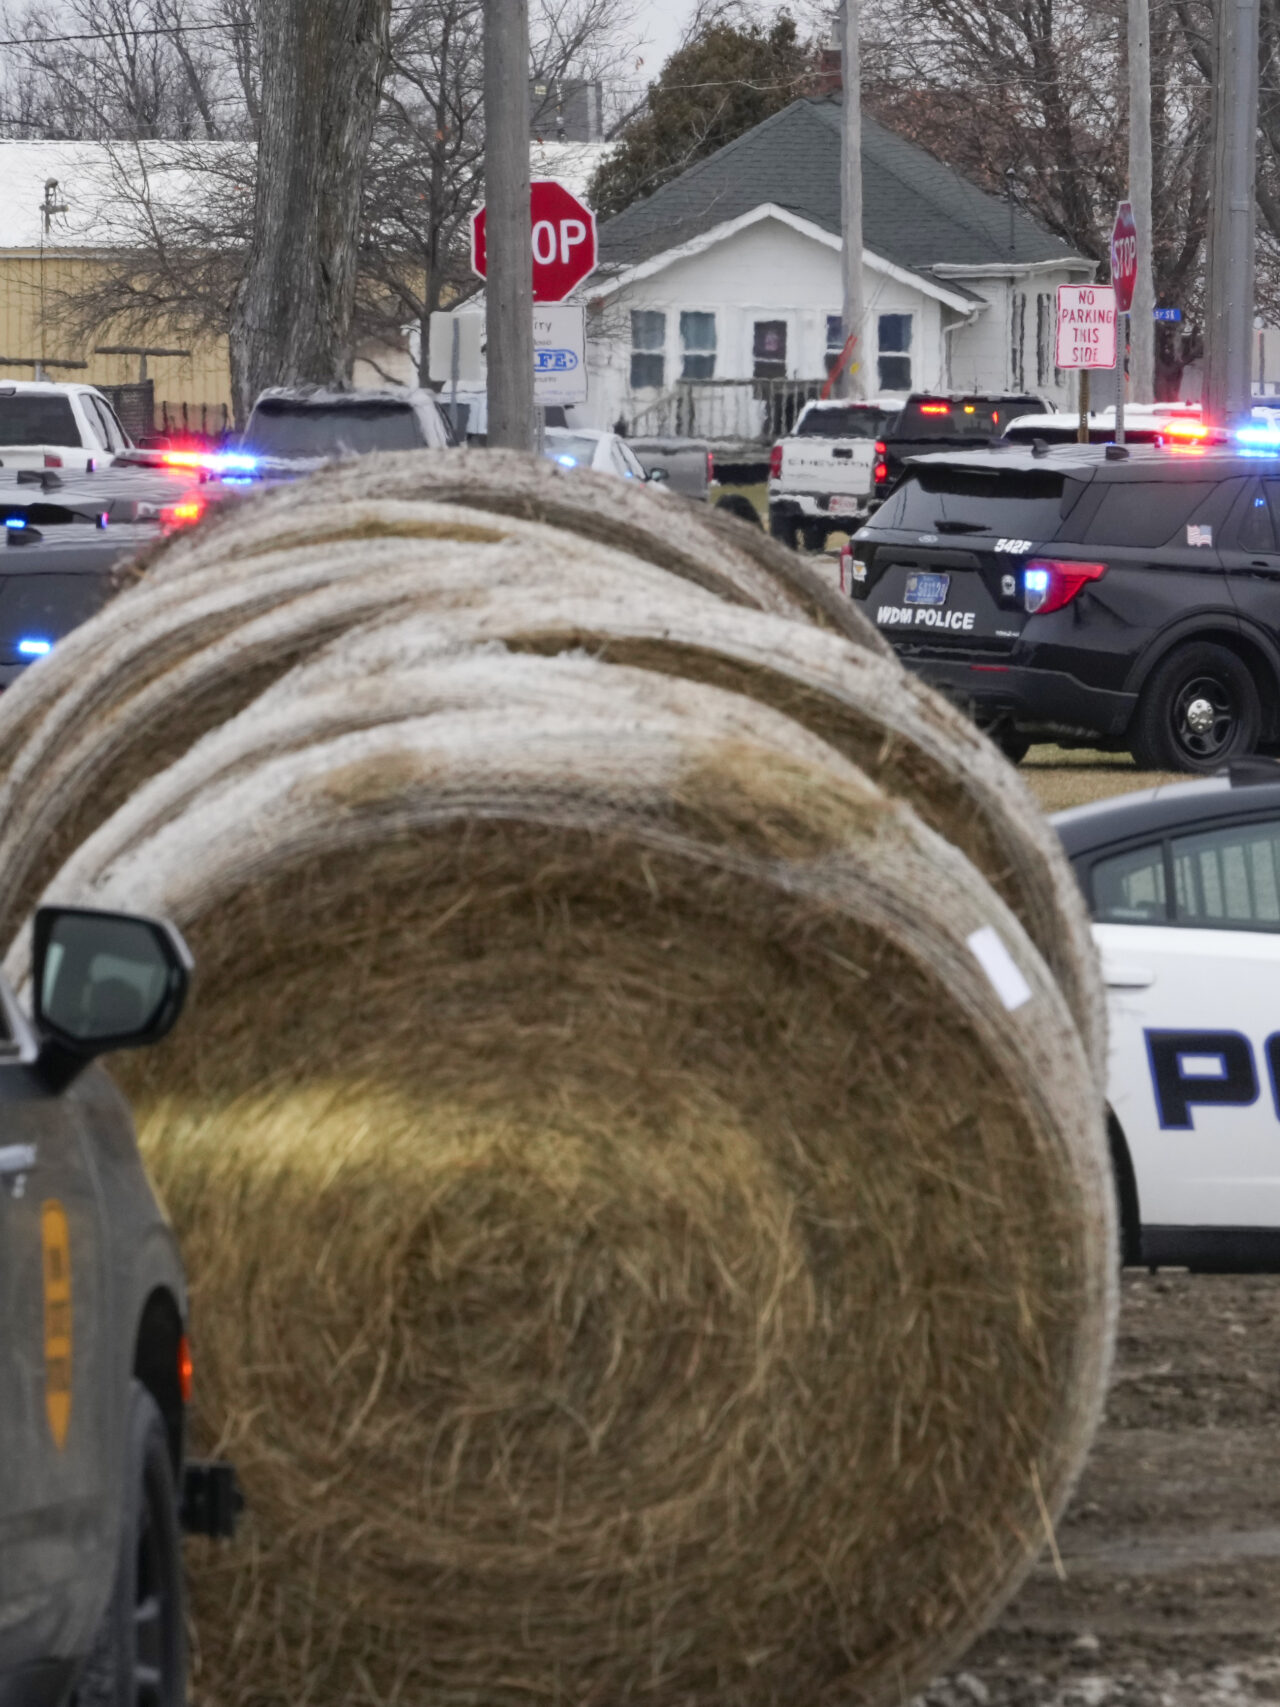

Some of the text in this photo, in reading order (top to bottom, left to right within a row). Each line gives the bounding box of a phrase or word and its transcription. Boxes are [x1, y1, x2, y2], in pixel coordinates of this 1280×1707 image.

[1113, 235, 1136, 280] STOP
[1078, 290, 1095, 305] NO
[1062, 309, 1113, 324] PARKING
[1073, 328, 1099, 343] THIS
[1072, 347, 1098, 362] SIDE
[993, 539, 1032, 554] 542F
[877, 606, 976, 630] WDM POLICE
